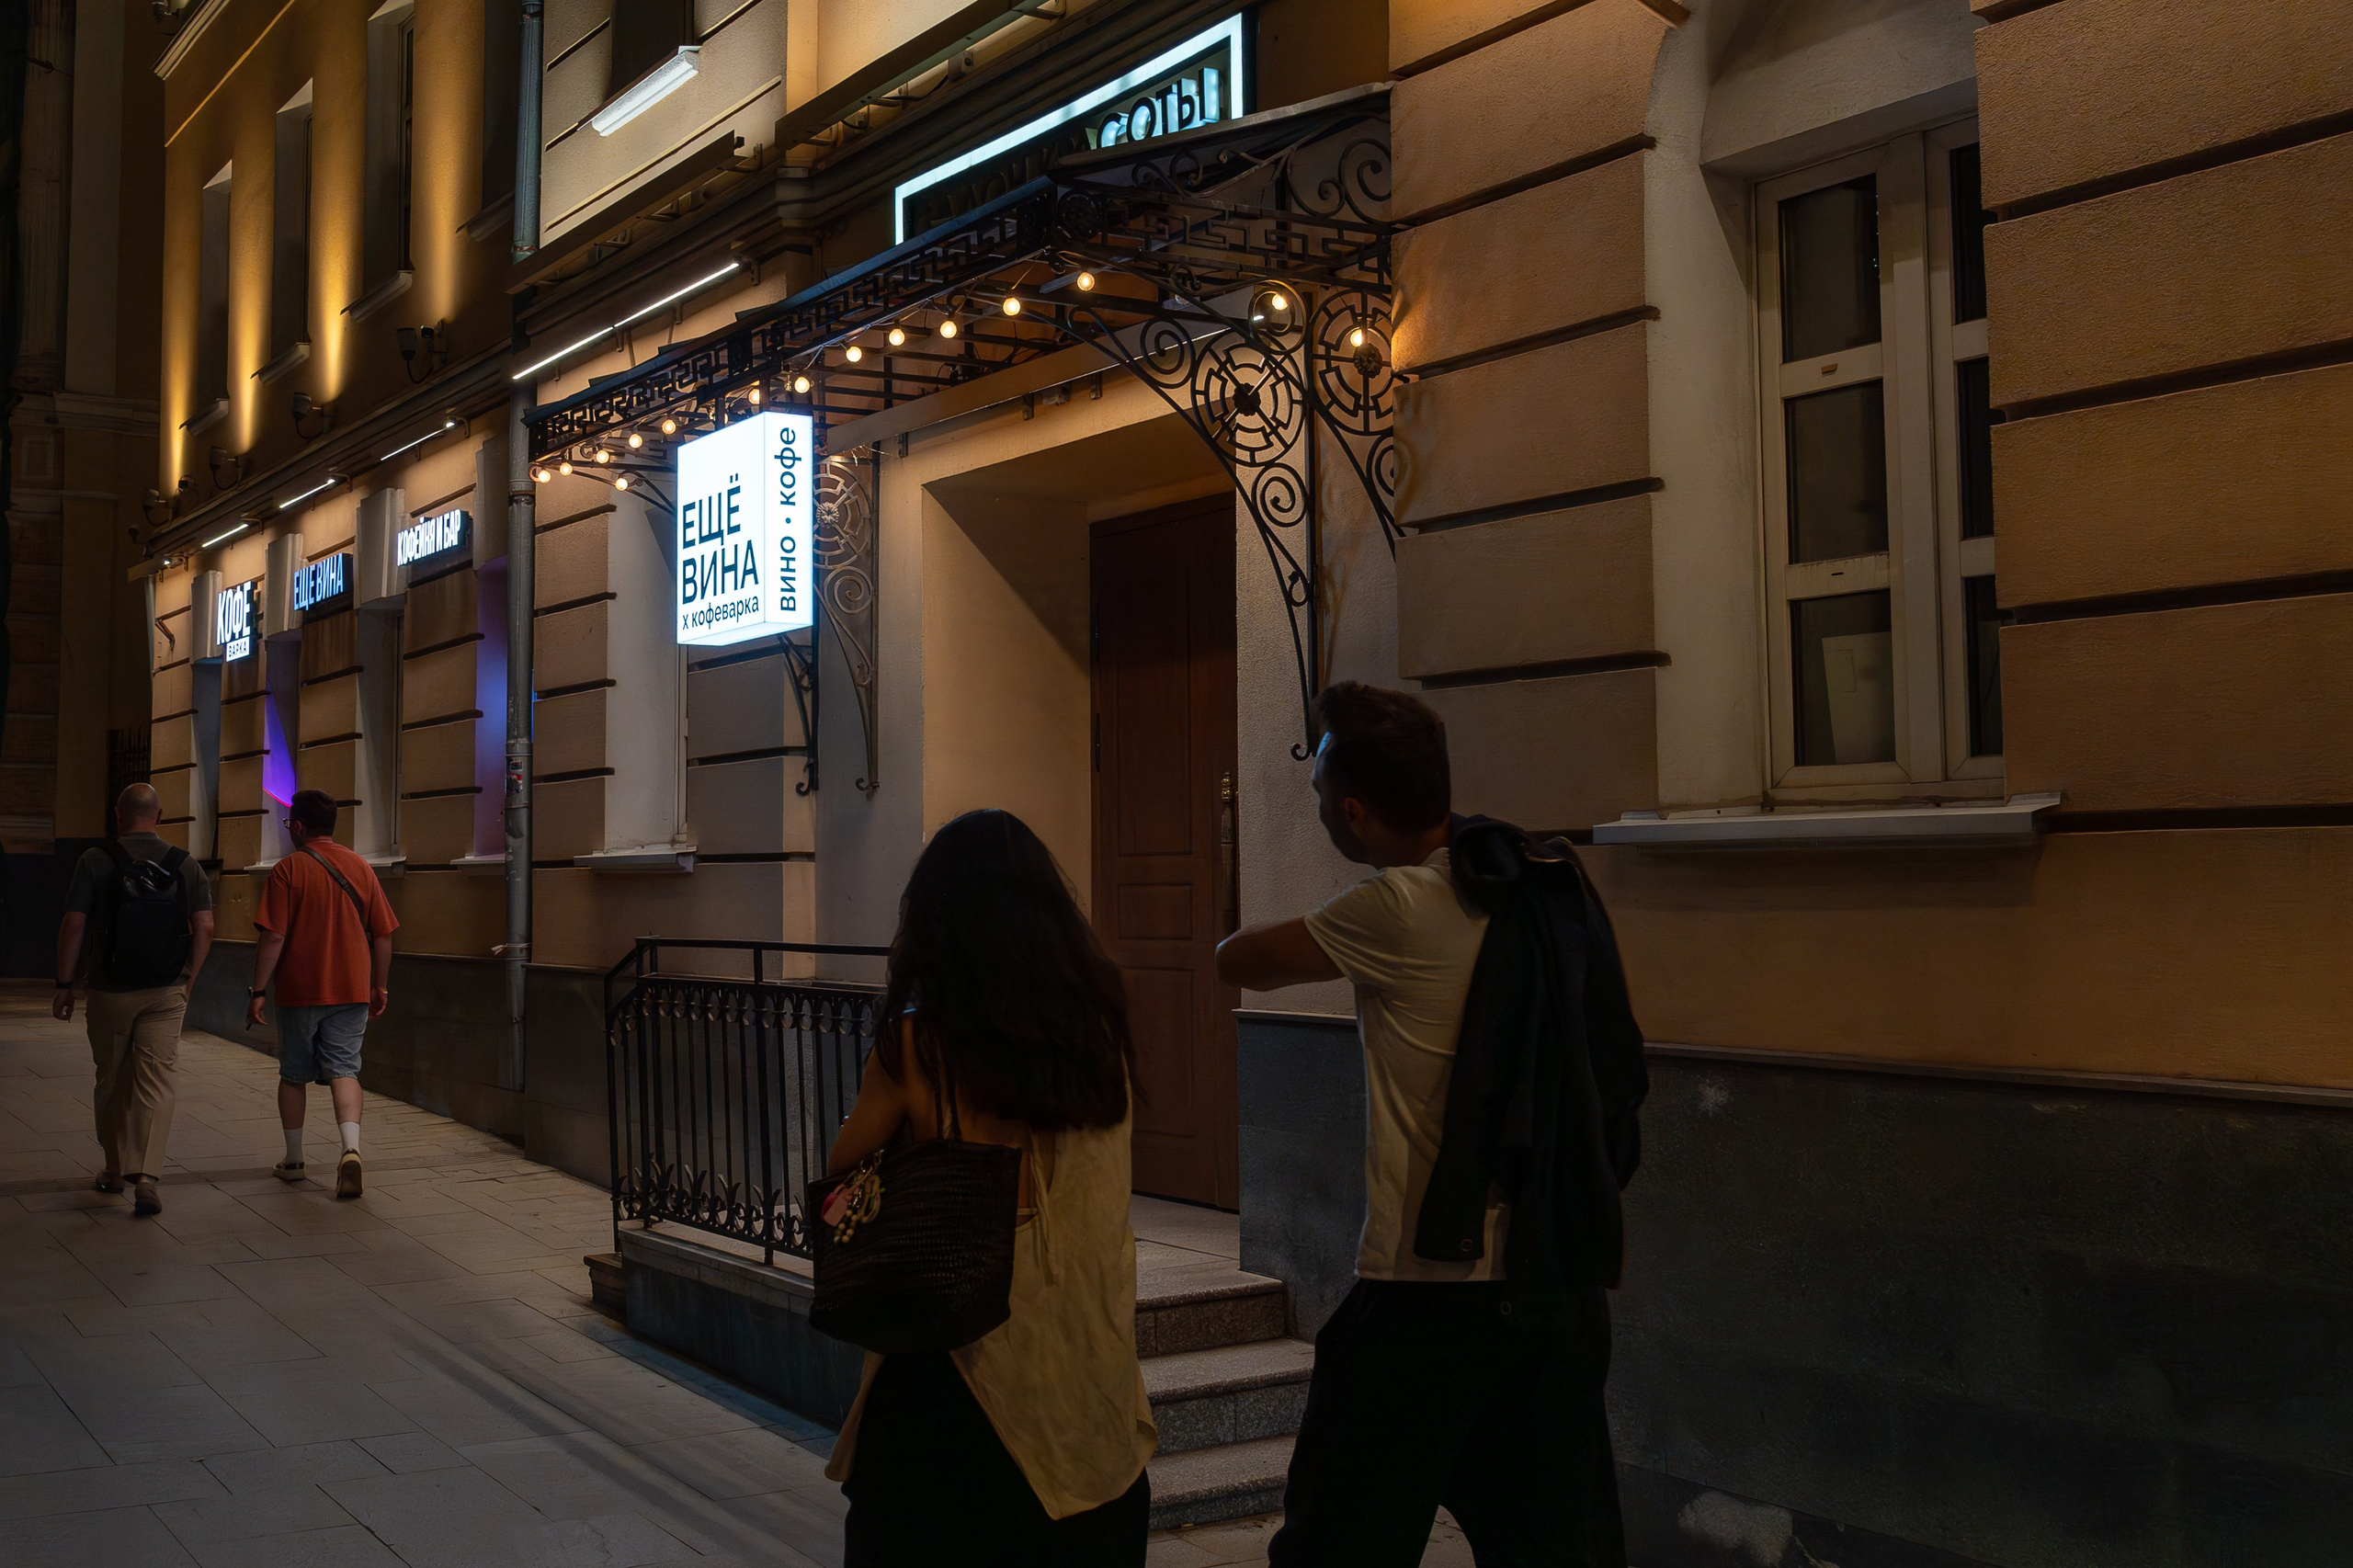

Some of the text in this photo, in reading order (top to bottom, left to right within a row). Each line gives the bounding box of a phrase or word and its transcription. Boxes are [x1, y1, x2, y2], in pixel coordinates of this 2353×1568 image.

[774, 427, 802, 506] кофе
[397, 508, 461, 566] КОФЕЙНЯ И БАР
[682, 472, 741, 550] ЕЩЁ
[294, 552, 343, 611] ЕЩЕ ВИНА
[682, 540, 759, 605] ВИНА
[216, 580, 252, 645] КОФЕ
[691, 596, 759, 630] кофеварка
[228, 640, 248, 658] ВАРКА
